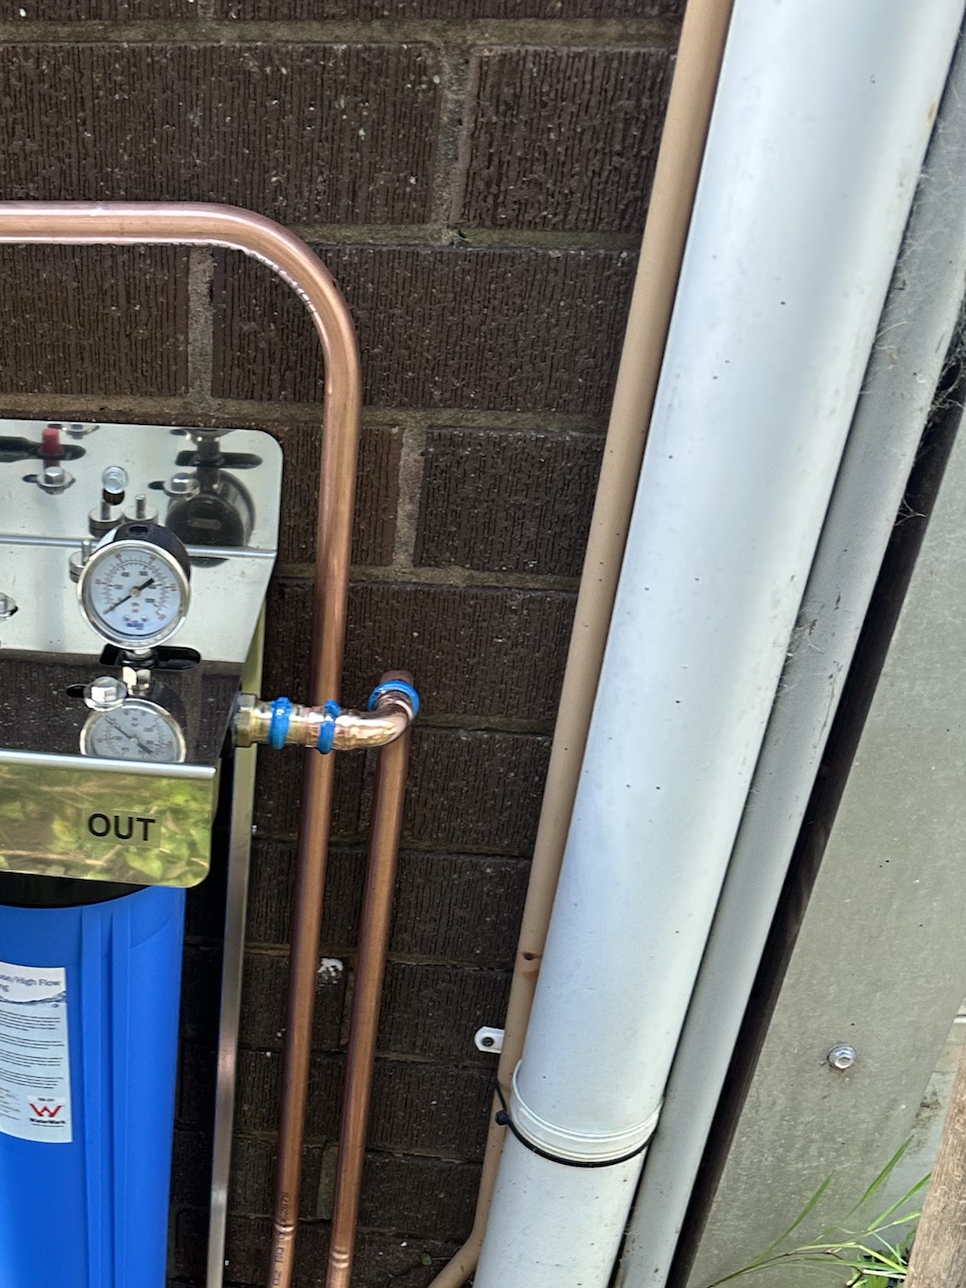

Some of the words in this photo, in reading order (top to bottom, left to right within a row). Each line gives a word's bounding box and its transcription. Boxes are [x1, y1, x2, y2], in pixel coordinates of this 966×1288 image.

[87, 813, 156, 841] OUT
[38, 979, 62, 987] Flow
[29, 1103, 65, 1117] W
